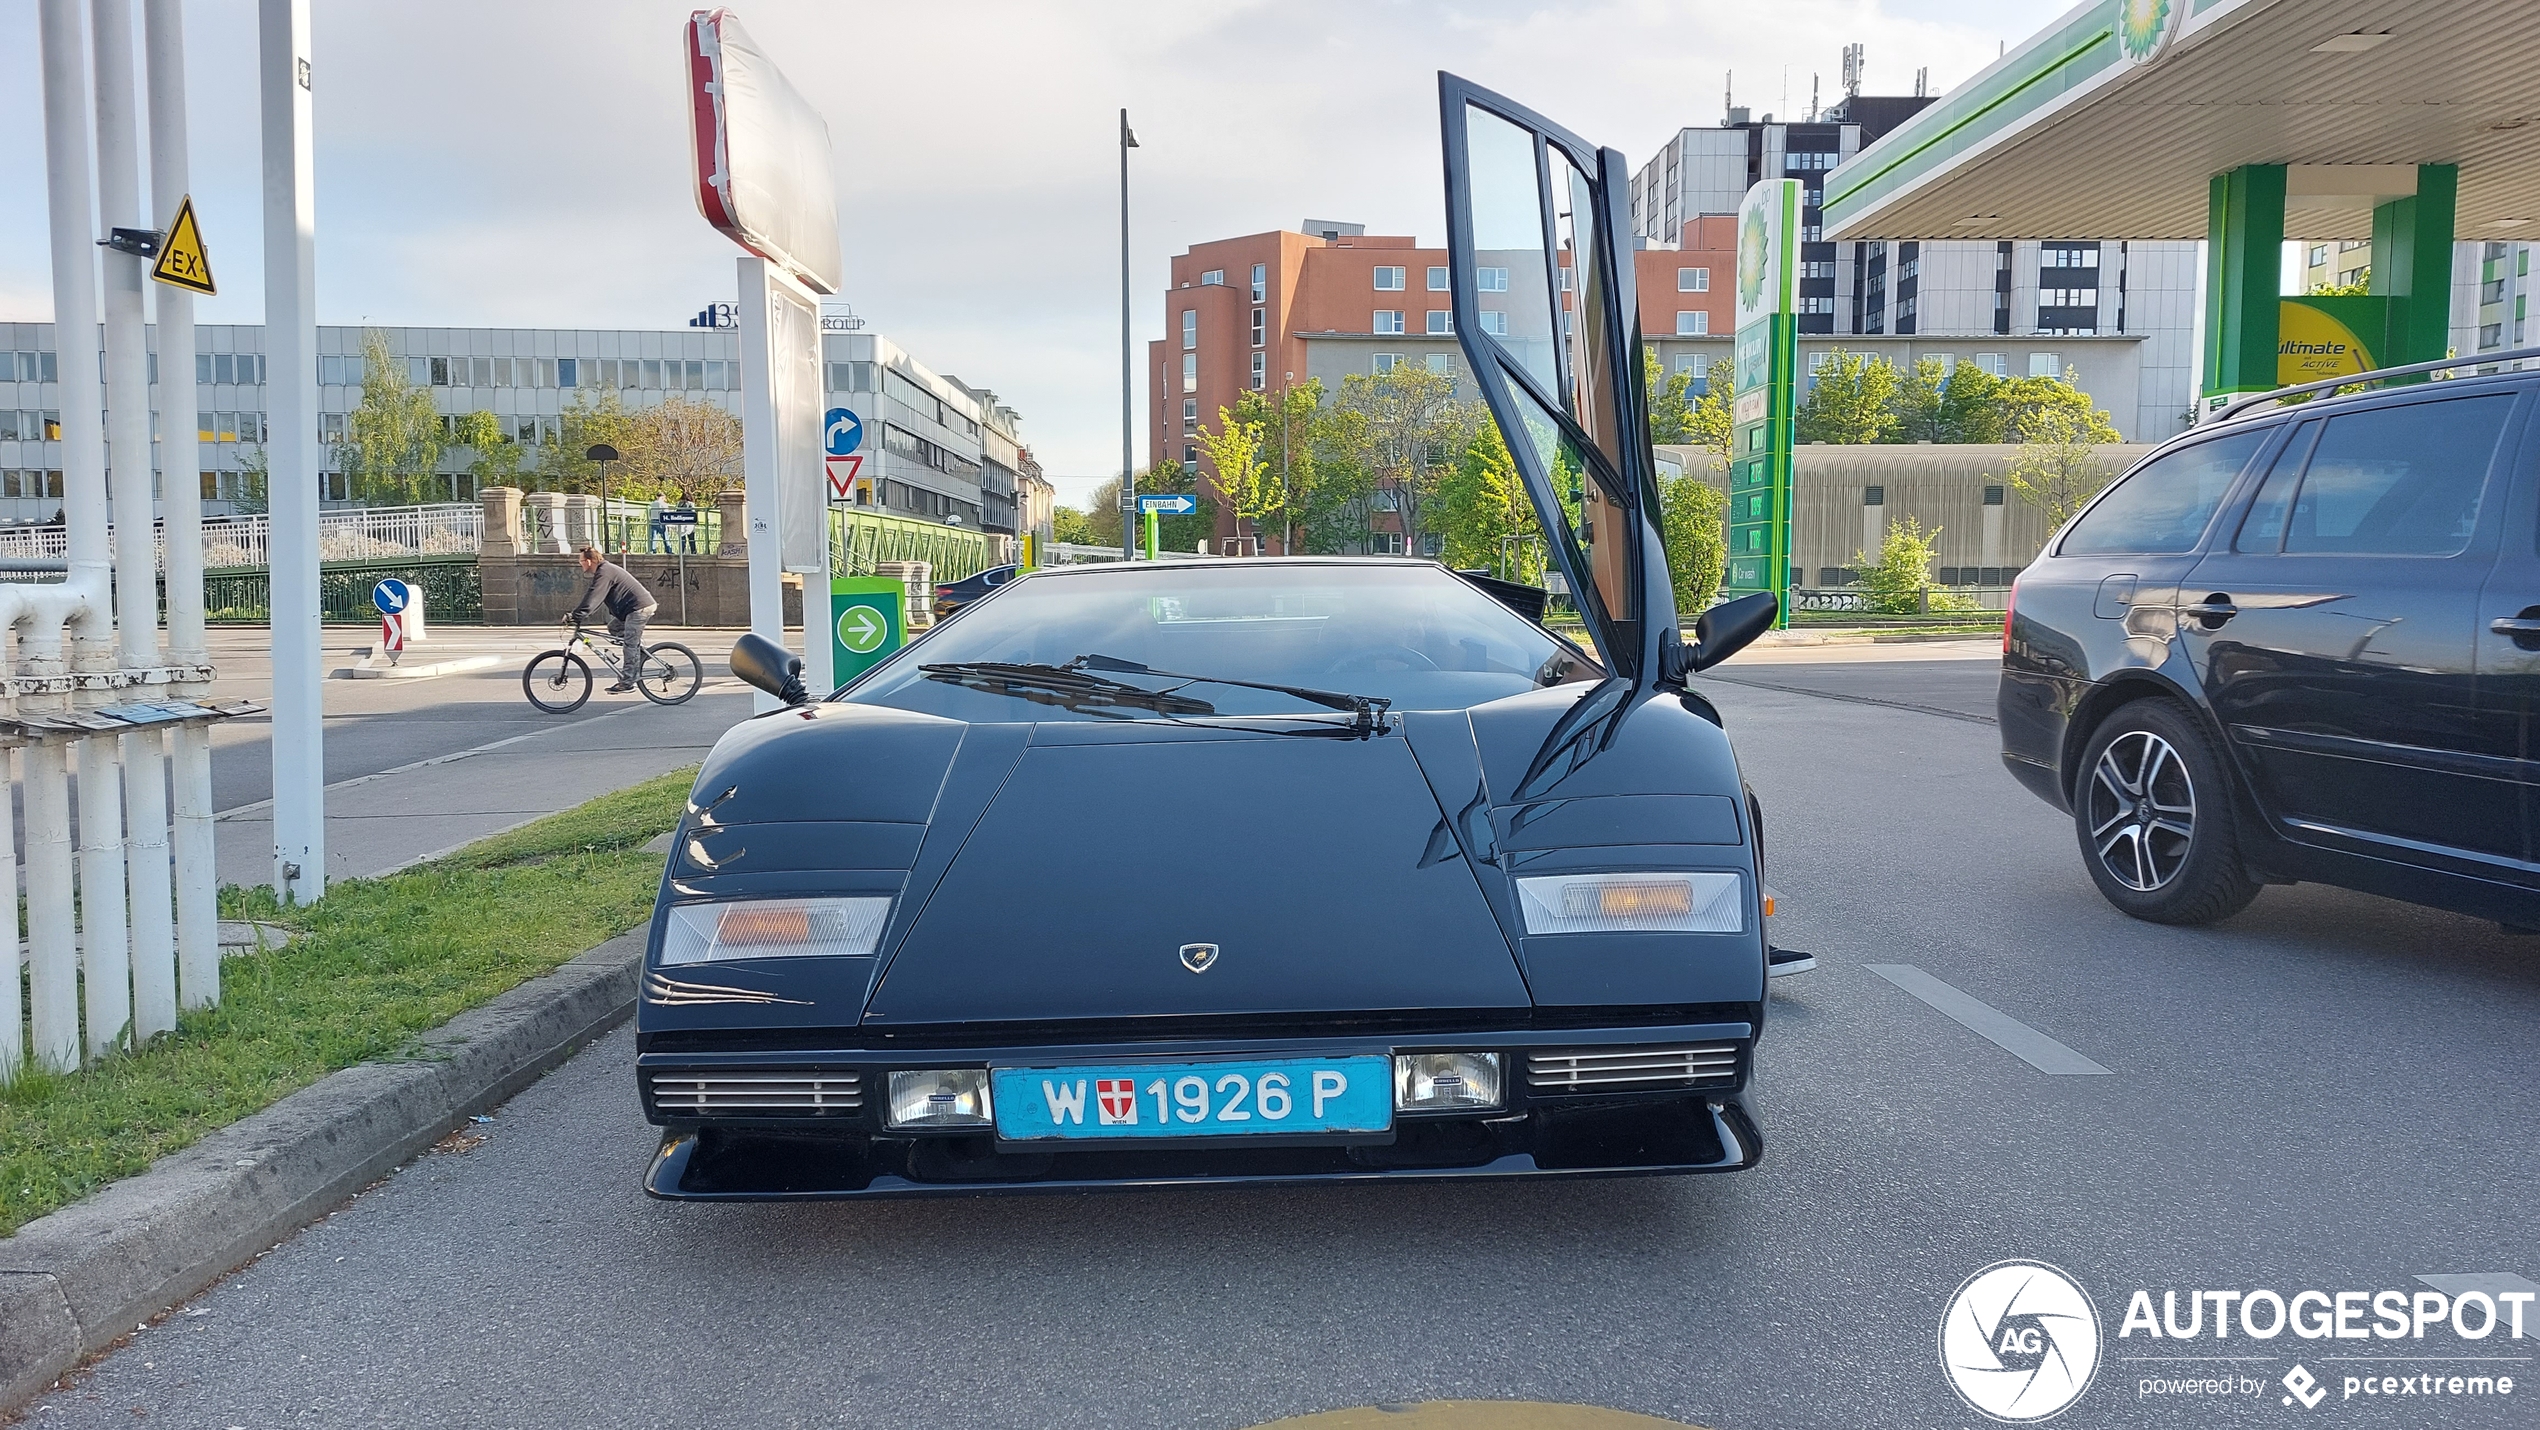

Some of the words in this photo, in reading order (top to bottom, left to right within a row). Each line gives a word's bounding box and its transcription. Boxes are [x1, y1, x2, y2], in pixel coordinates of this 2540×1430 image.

[1762, 187, 1770, 207] bp
[172, 249, 198, 278] EX
[821, 318, 865, 330] ROUP
[1738, 338, 1762, 362] MERKUR
[1042, 1079, 1088, 1126] W
[1146, 1071, 1292, 1124] 1926
[1312, 1070, 1348, 1119] P
